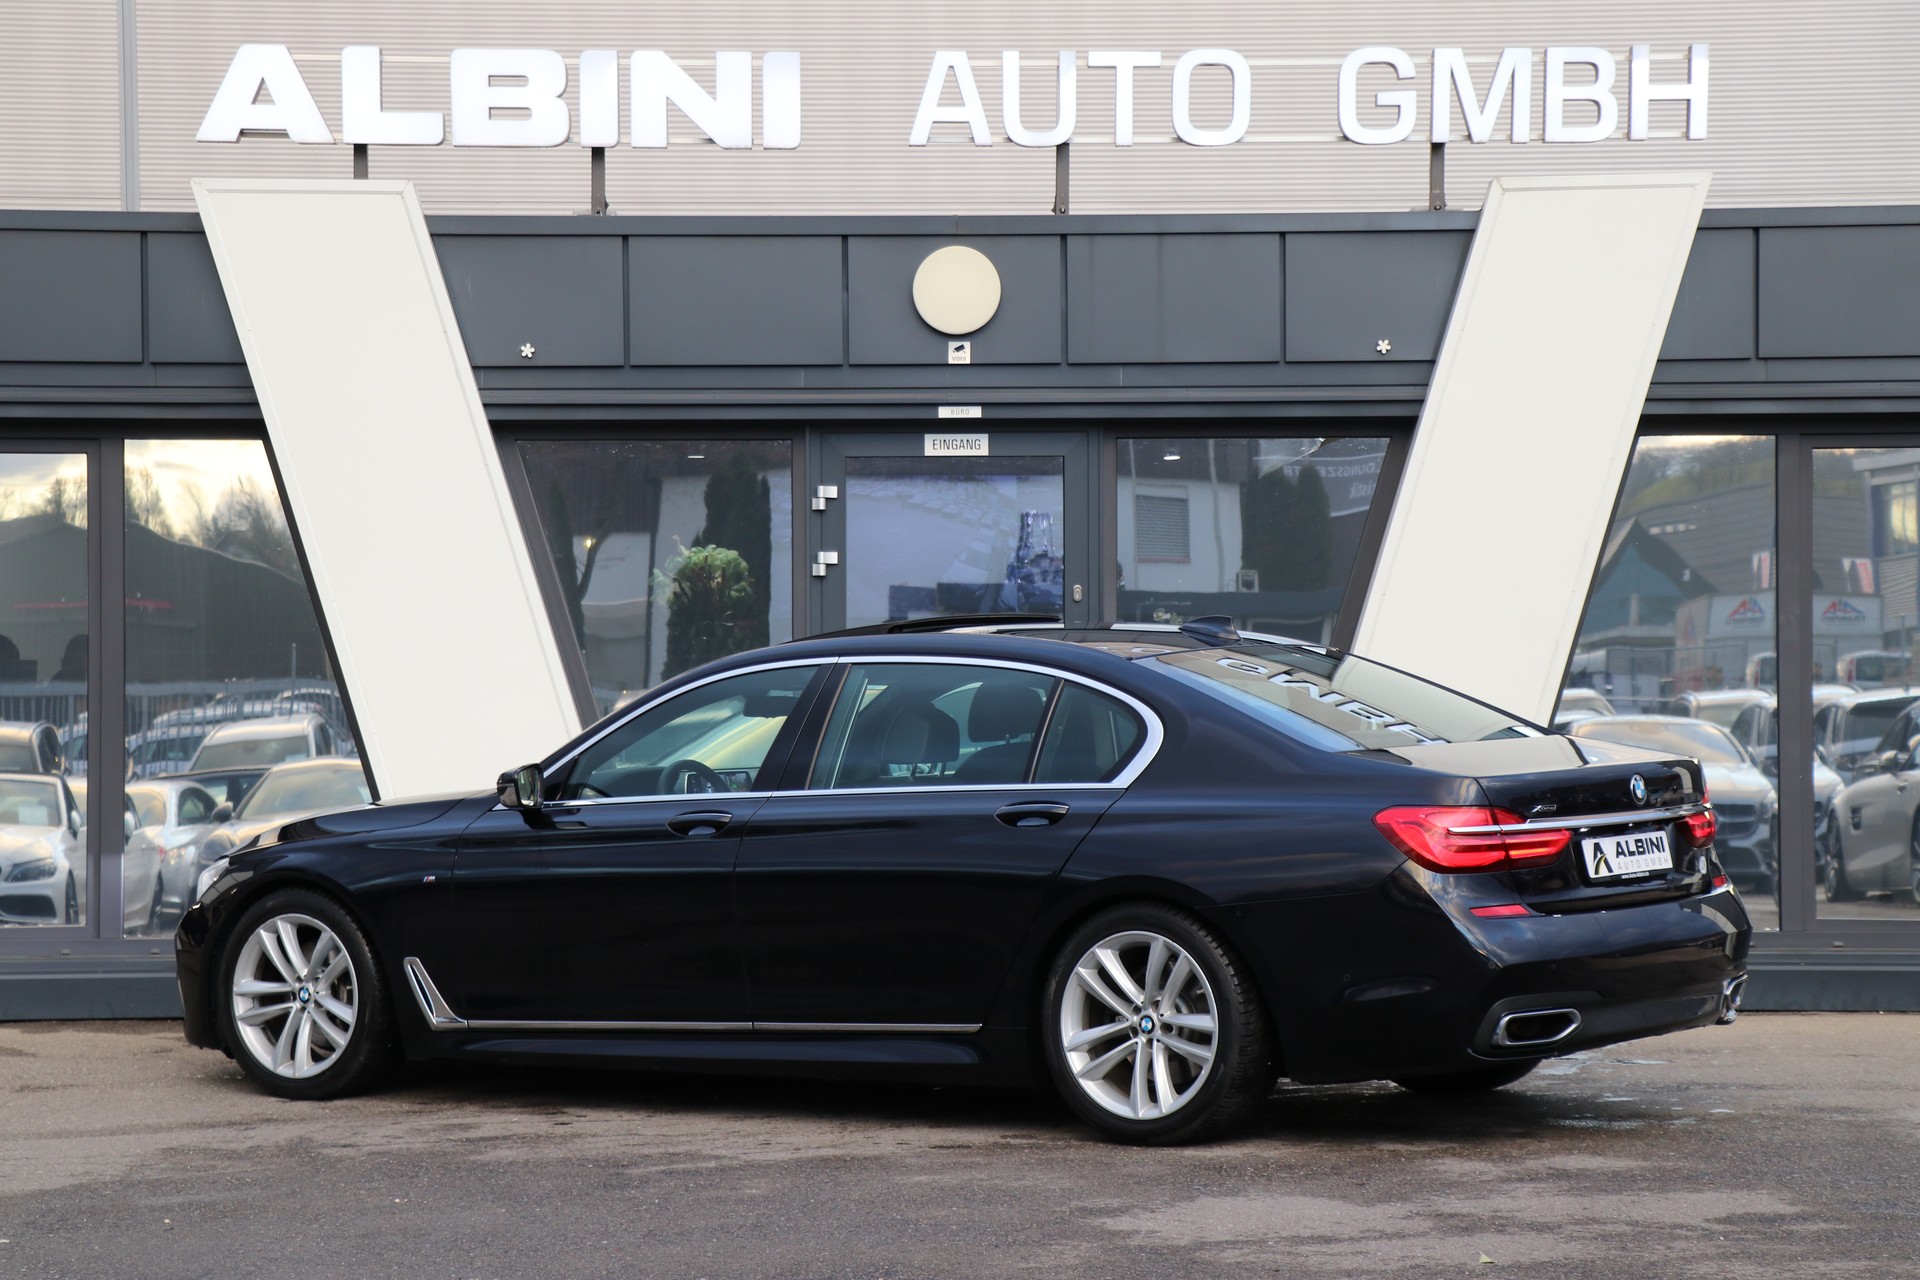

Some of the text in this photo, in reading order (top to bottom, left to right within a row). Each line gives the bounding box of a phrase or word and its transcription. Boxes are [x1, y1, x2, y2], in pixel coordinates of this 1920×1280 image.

[194, 43, 1710, 150] ALBINI AUTO GMBH
[950, 407, 970, 416] BÜRO
[932, 438, 982, 451] EINGANG
[1616, 836, 1666, 859] ALBINI
[1617, 855, 1670, 872] AUTO GMBH
